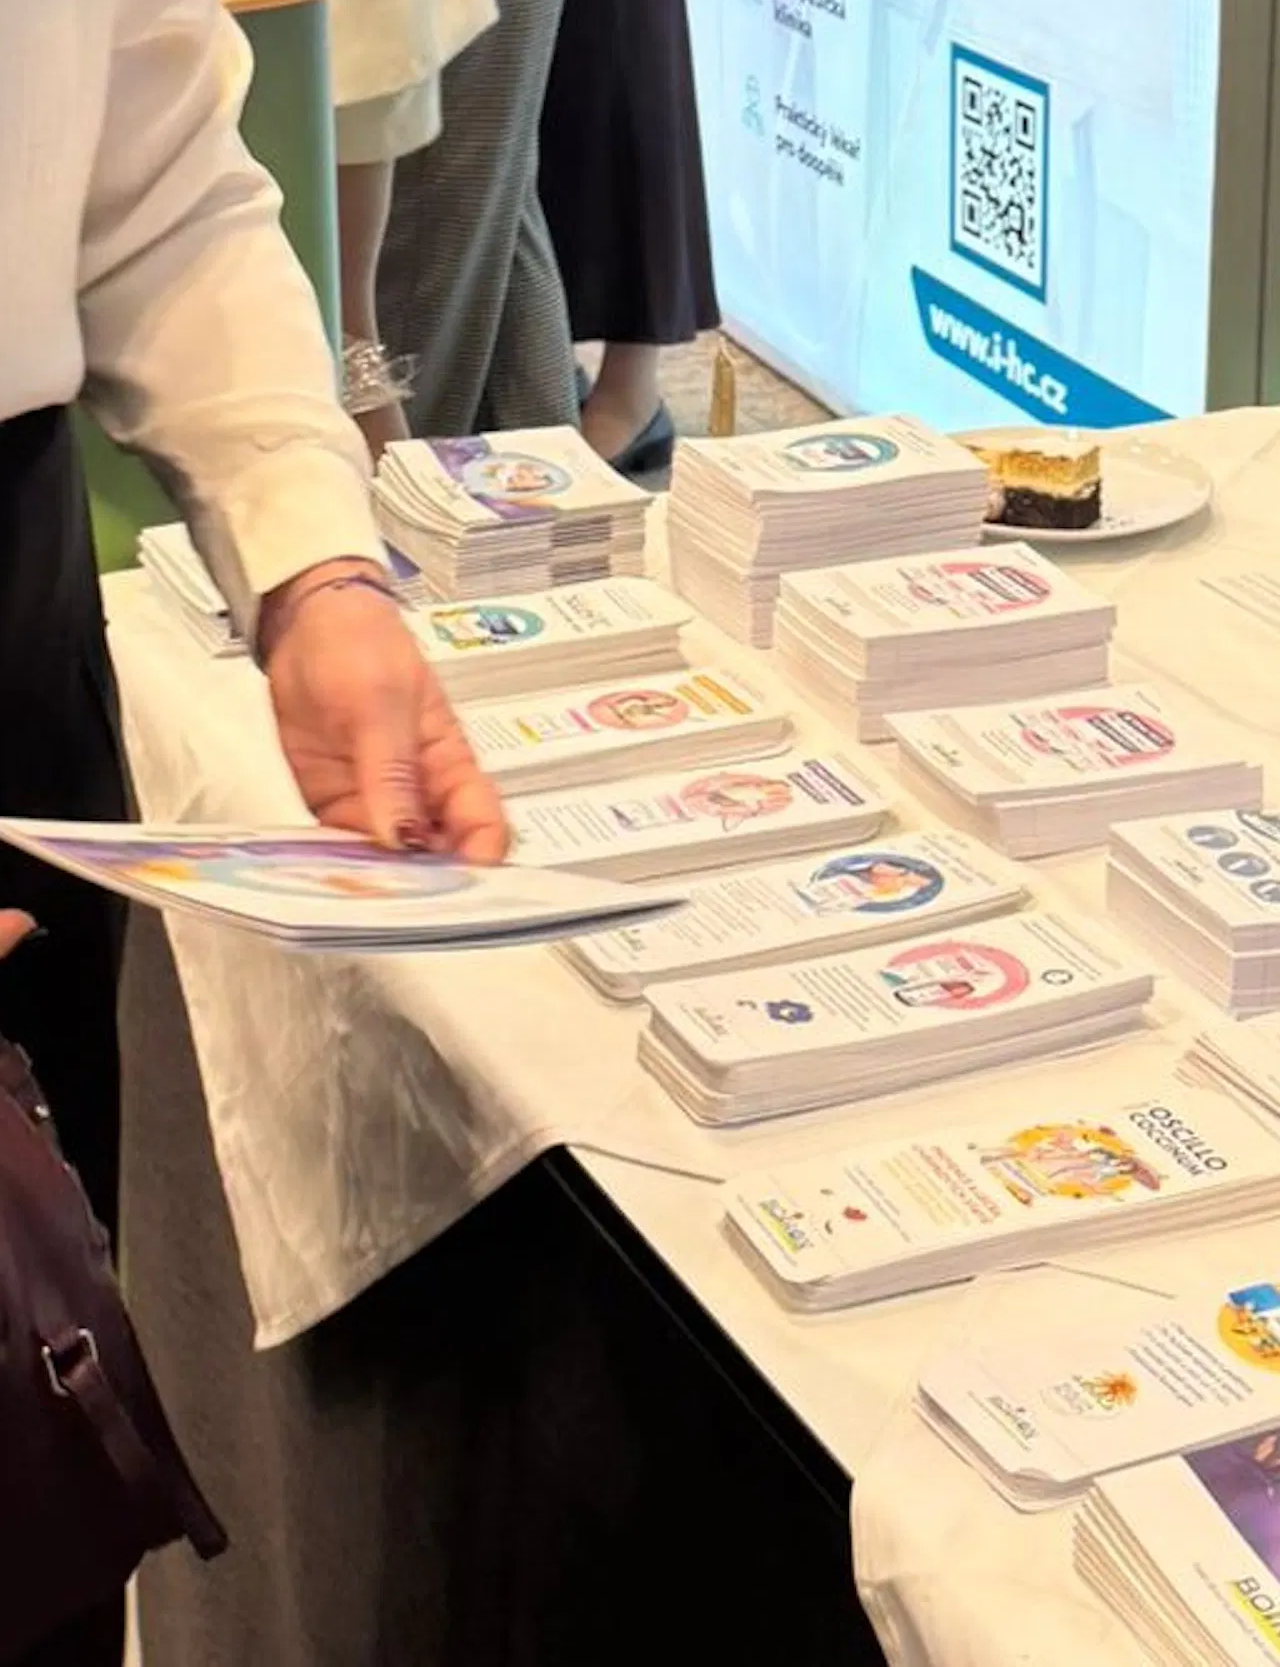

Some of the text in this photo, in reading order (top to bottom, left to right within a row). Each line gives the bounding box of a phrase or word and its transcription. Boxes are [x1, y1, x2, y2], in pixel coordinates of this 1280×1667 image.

[928, 301, 1071, 416] www.i-hc.cz
[1129, 1112, 1204, 1175] COCCINUM
[1149, 1107, 1227, 1170] OSCILLO
